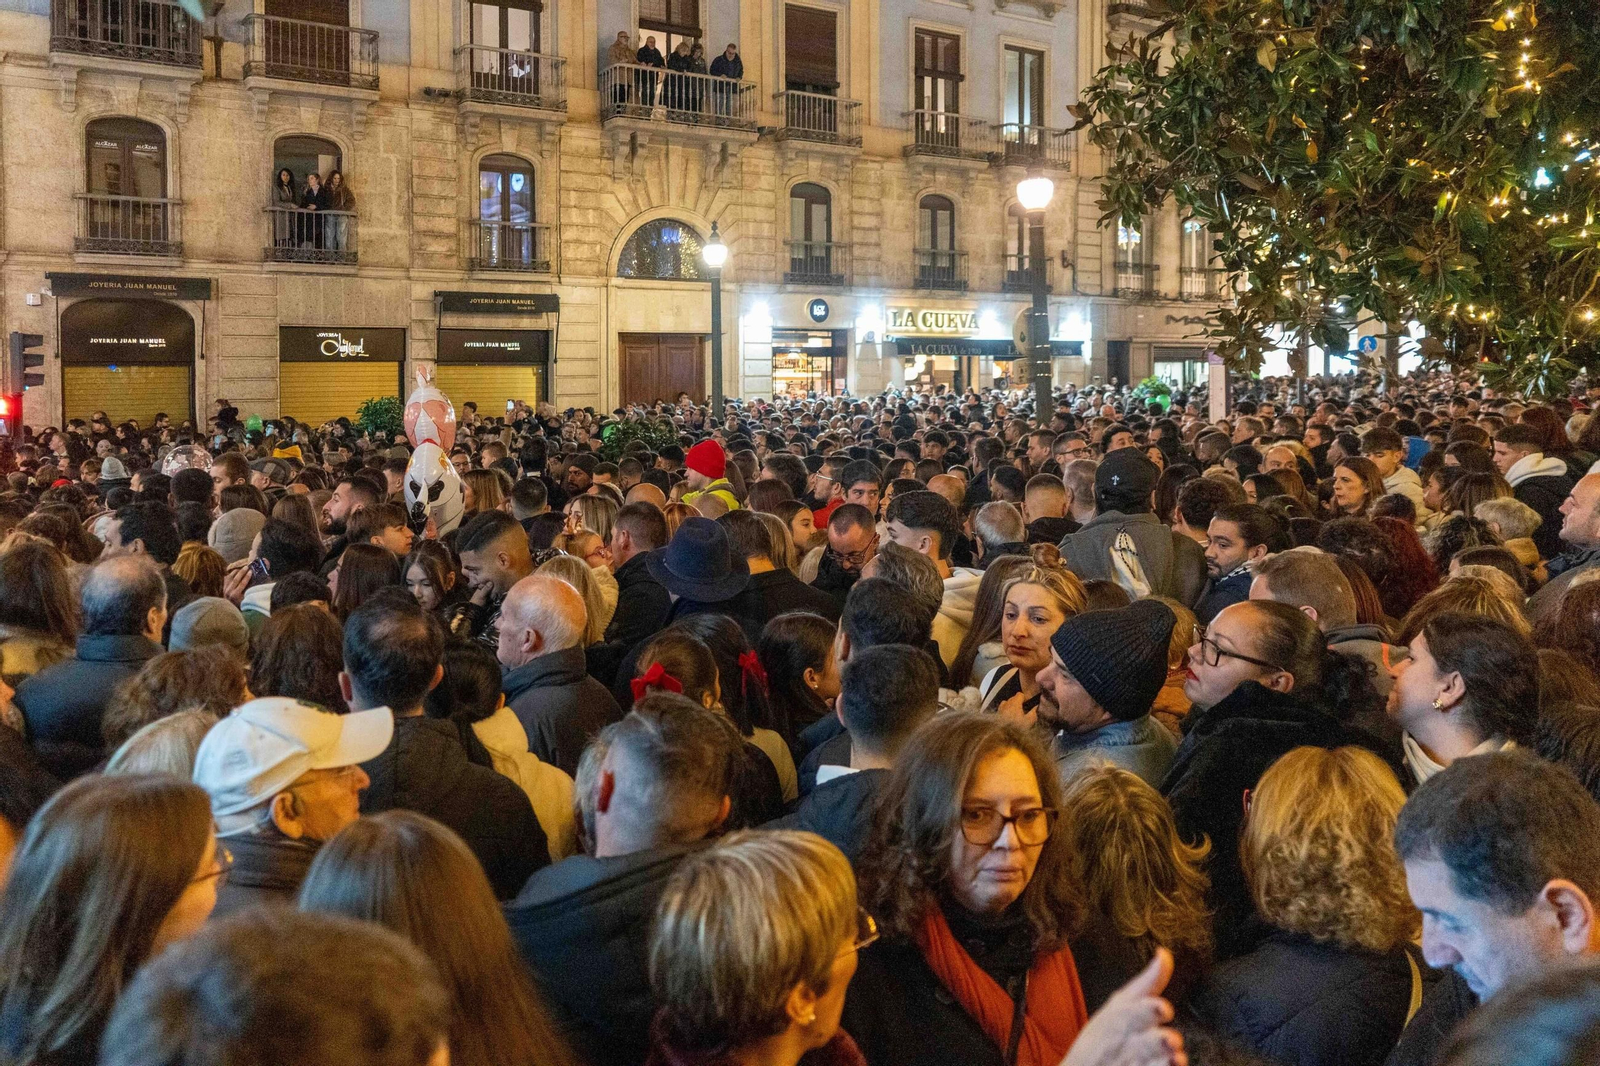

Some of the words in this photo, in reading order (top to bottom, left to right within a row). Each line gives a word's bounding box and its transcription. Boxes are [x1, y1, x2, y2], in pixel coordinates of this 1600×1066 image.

[891, 312, 917, 327] LA
[921, 312, 979, 328] CUEVA
[910, 344, 924, 355] LA
[925, 344, 958, 355] CUEVA
